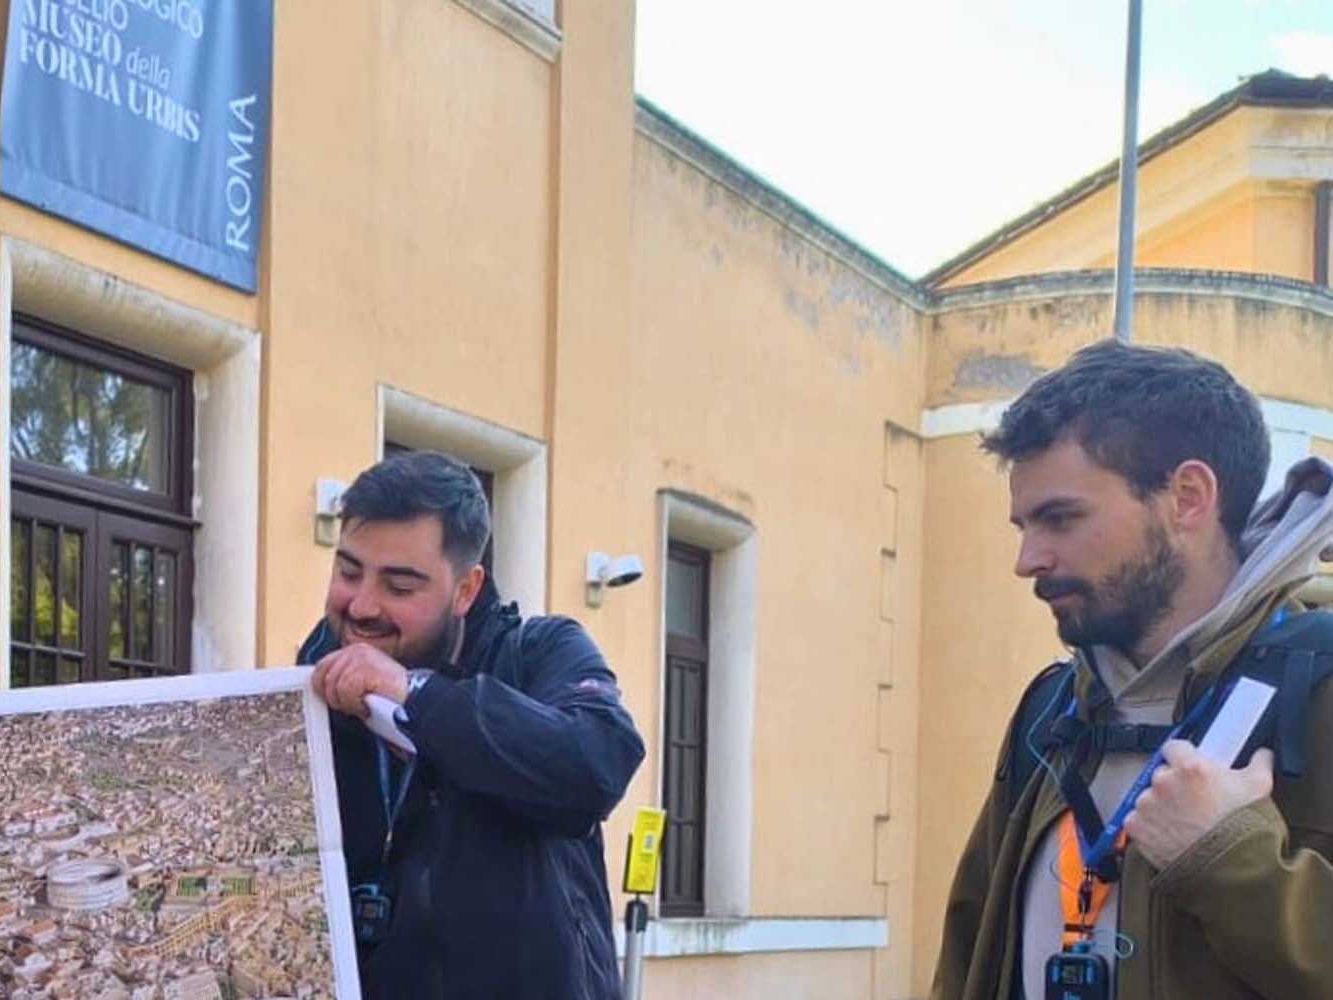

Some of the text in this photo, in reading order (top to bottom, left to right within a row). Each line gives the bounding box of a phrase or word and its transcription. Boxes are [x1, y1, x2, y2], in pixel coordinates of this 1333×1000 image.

[20, 27, 201, 143] FORMA URBIS
[22, 0, 170, 89] MUSEO della
[225, 93, 256, 251] ROMA
